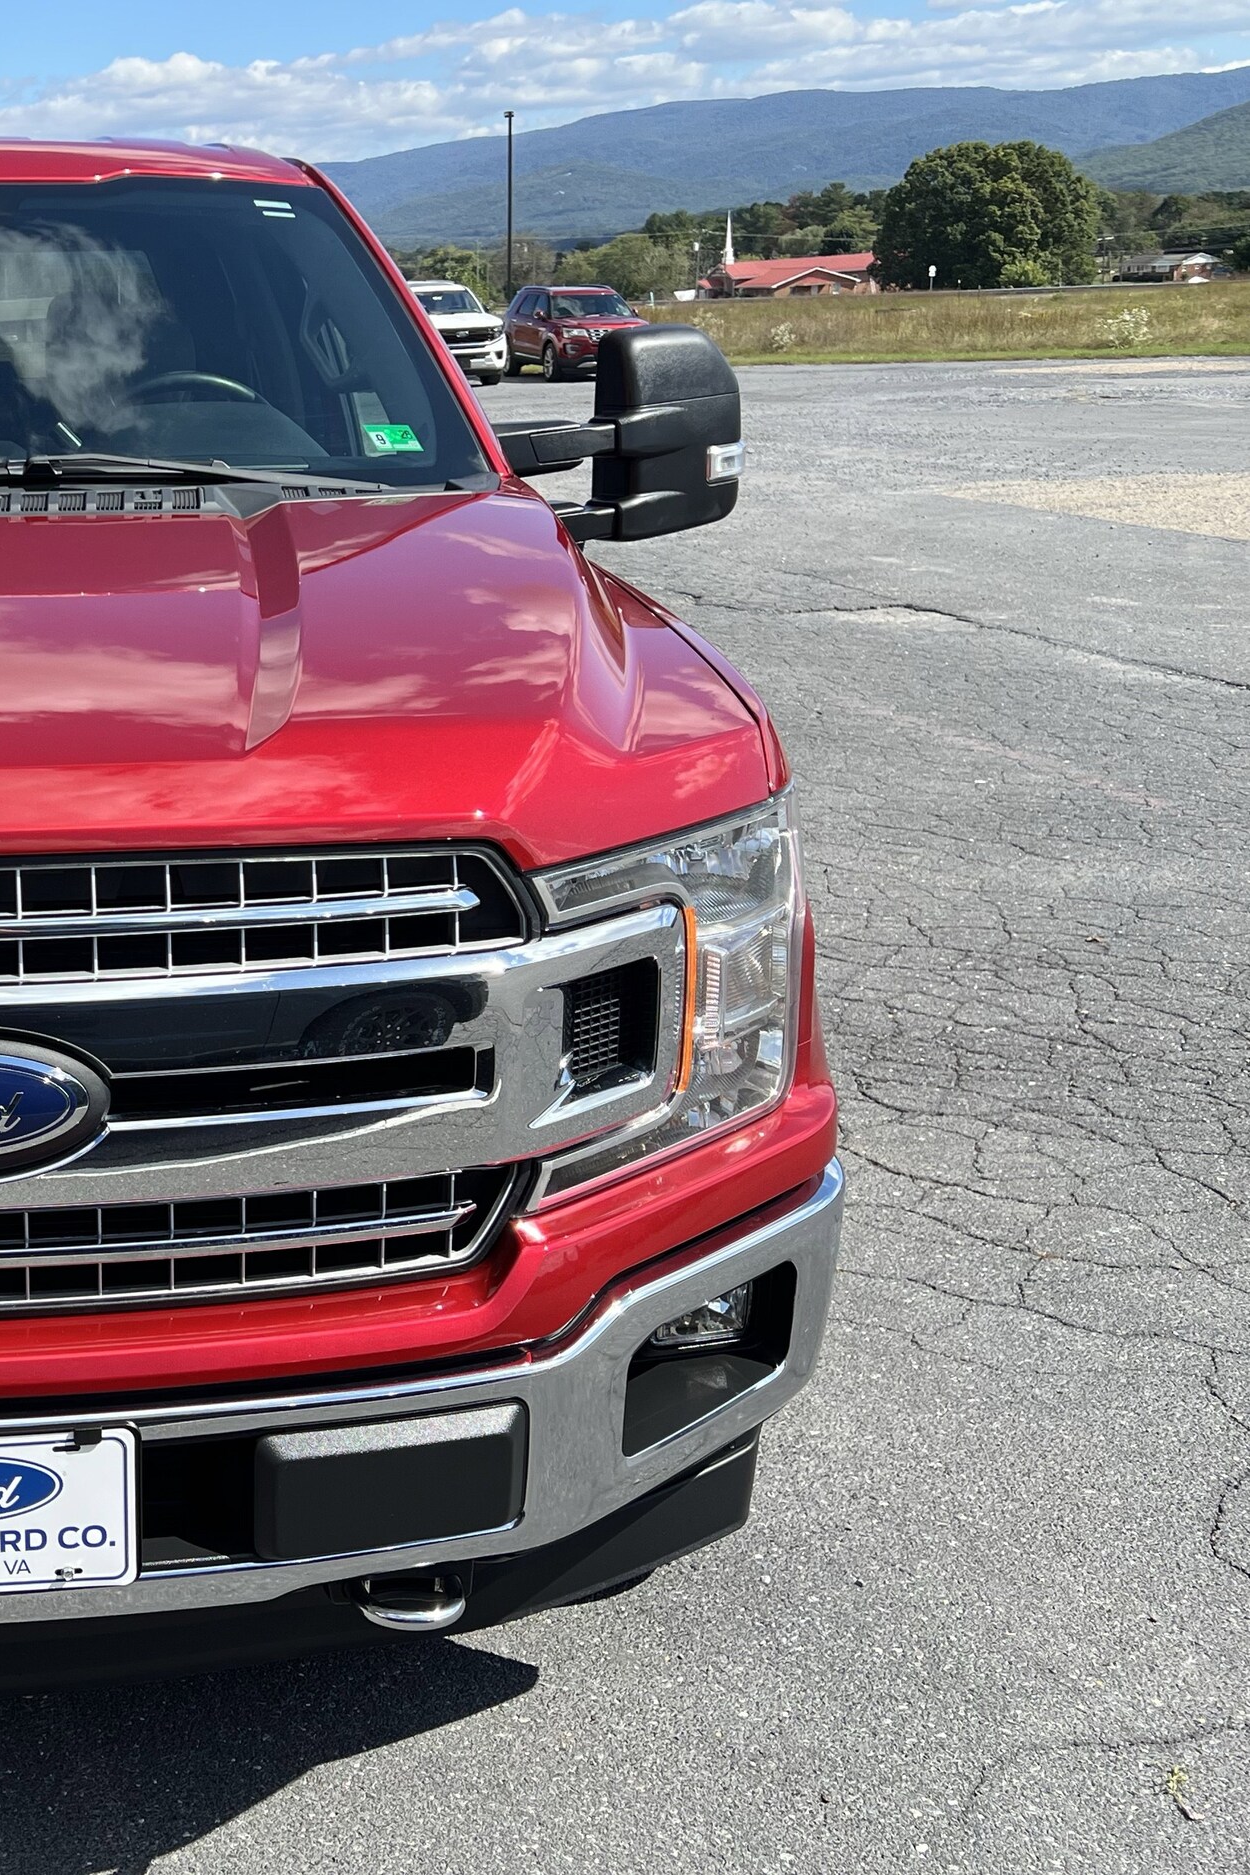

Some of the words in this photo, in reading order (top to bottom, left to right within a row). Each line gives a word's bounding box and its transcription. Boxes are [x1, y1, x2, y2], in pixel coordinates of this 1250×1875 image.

[375, 433, 386, 445] 9
[57, 1525, 116, 1549] CO.
[4, 1559, 32, 1576] VA
